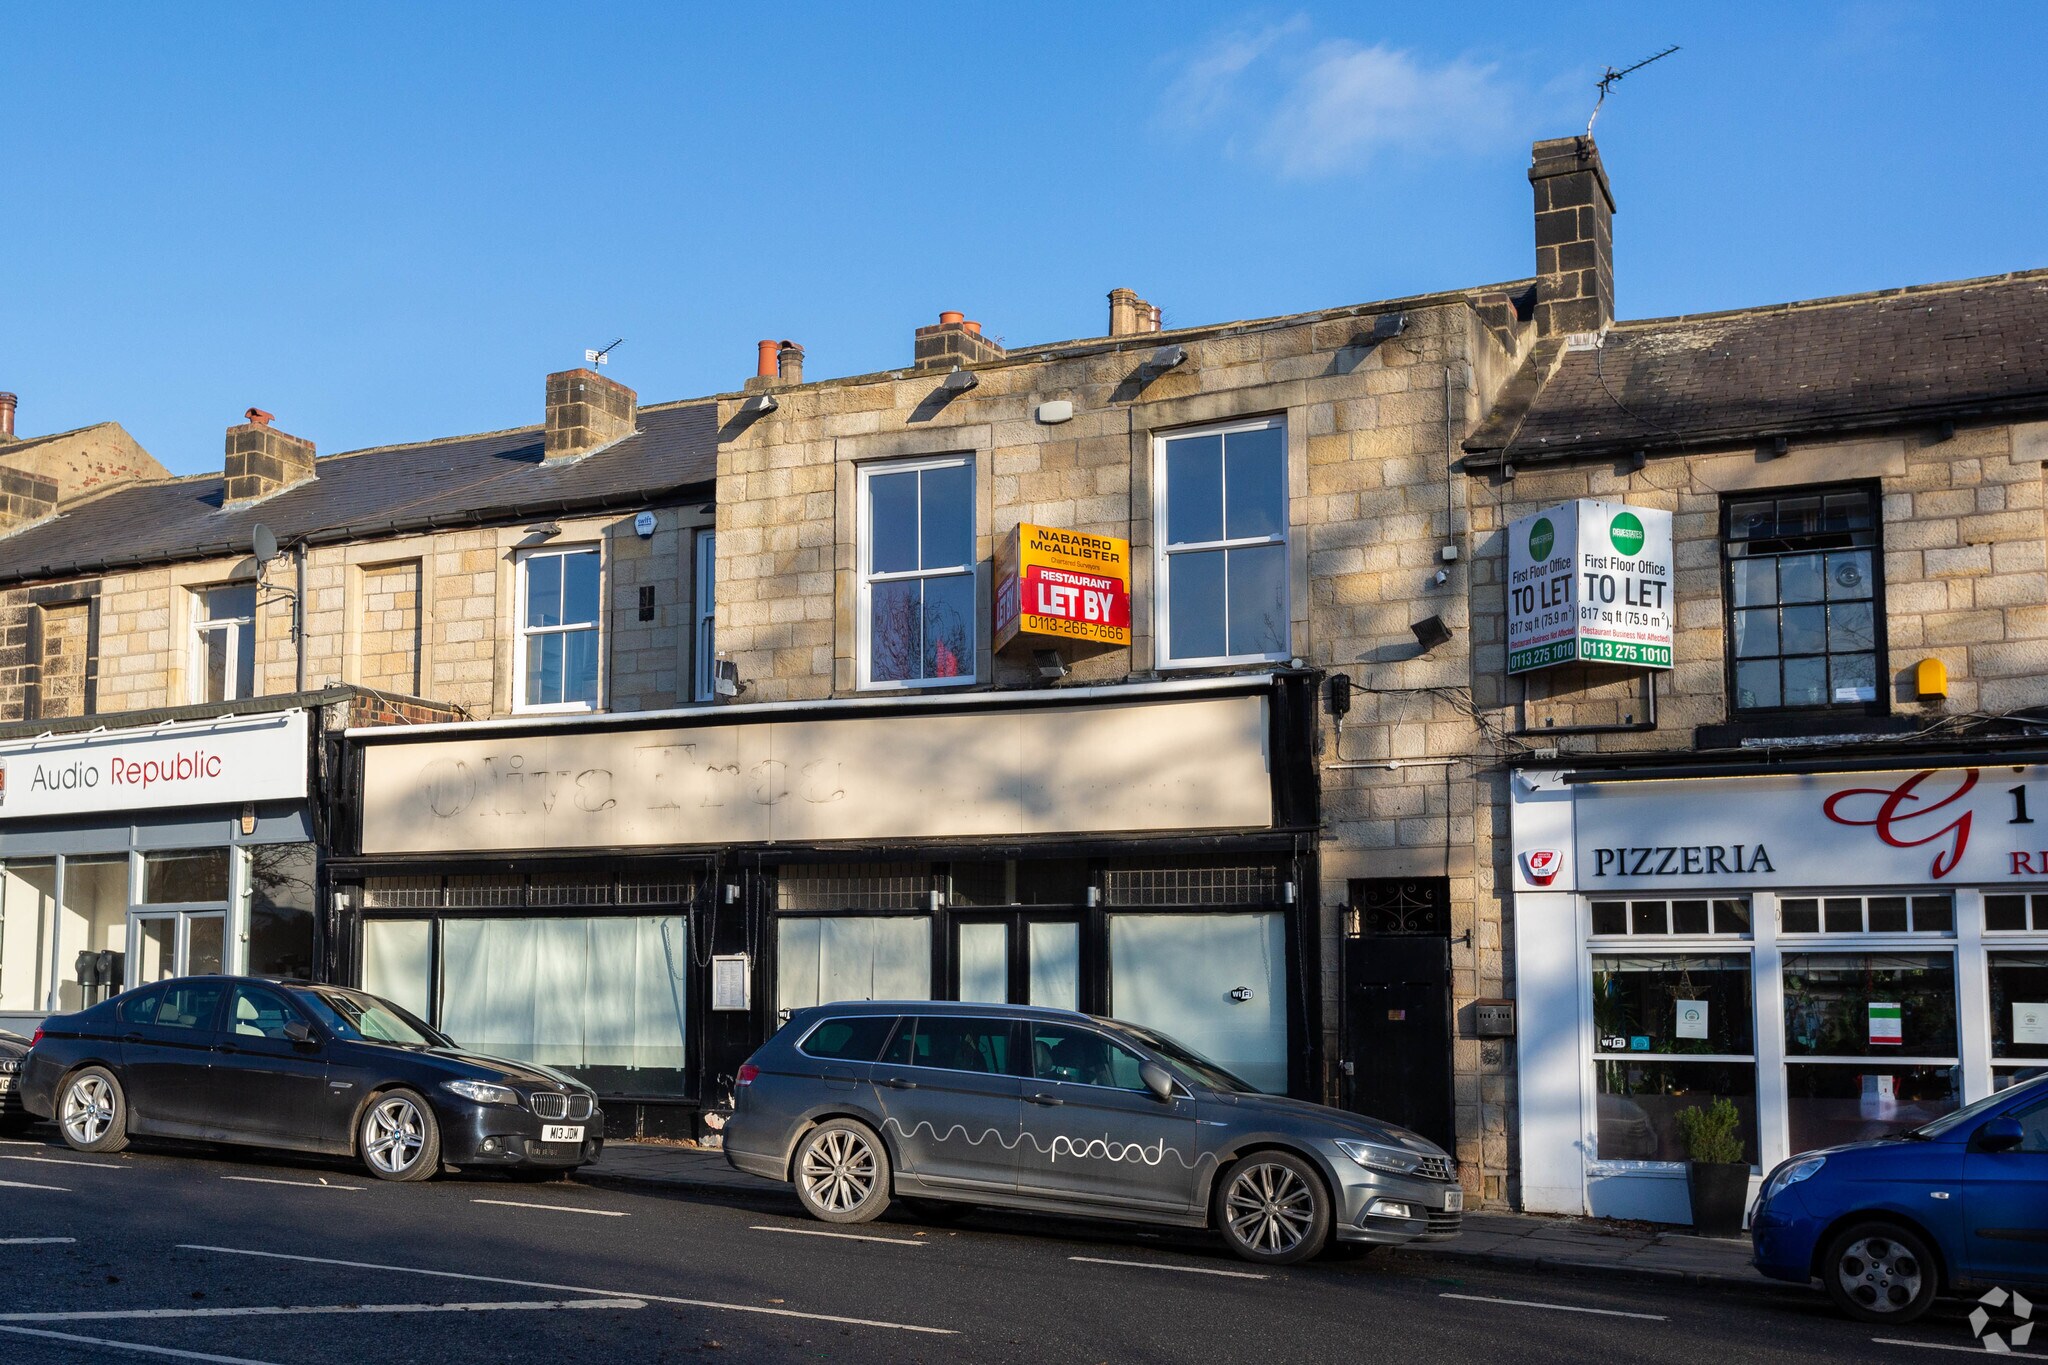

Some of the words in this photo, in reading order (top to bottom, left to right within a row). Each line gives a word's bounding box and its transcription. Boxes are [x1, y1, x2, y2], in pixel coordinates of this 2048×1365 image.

[1030, 540, 1120, 563] McALLISTER
[1038, 530, 1112, 550] NABARRO
[1050, 557, 1076, 567] Chartered
[1076, 561, 1101, 571] Surveyors
[1512, 569, 1528, 584] First
[1530, 565, 1548, 579] Floor
[1550, 557, 1571, 573] Office
[1585, 554, 1607, 569] First
[1611, 557, 1635, 572] Floor
[1639, 560, 1666, 576] Office
[1040, 570, 1112, 590] RESTAURANT
[1584, 573, 1616, 604] TO
[1625, 577, 1667, 609] LET
[1038, 583, 1079, 617] LET
[1084, 590, 1114, 622] BY
[1512, 585, 1534, 616] TO
[1541, 574, 1572, 609] LET
[1029, 615, 1124, 640] 0113-266-7666
[1510, 621, 1523, 635] 817
[1525, 621, 1533, 633] sq
[1535, 617, 1540, 629] ft
[1542, 611, 1559, 629] (75.9
[1581, 606, 1599, 620] 817
[1602, 611, 1613, 624] sq
[1616, 610, 1622, 622] ft
[1625, 611, 1648, 626] (75.9
[1532, 633, 1549, 644] Business
[1581, 626, 1612, 637] (Restaurant
[1612, 629, 1636, 639] Business
[1636, 632, 1645, 640] Not
[1647, 634, 1670, 644] Affected)
[1511, 652, 1532, 669] 0113
[1534, 648, 1550, 663] 275
[1552, 641, 1574, 659] 1010
[1583, 641, 1612, 658] 0113
[1616, 644, 1637, 660] 275
[1641, 647, 1669, 663] 1010
[31, 761, 99, 792] Audio
[111, 750, 221, 790] Republic
[1595, 844, 1775, 877] PIZZERIA
[550, 1127, 563, 1139] M13
